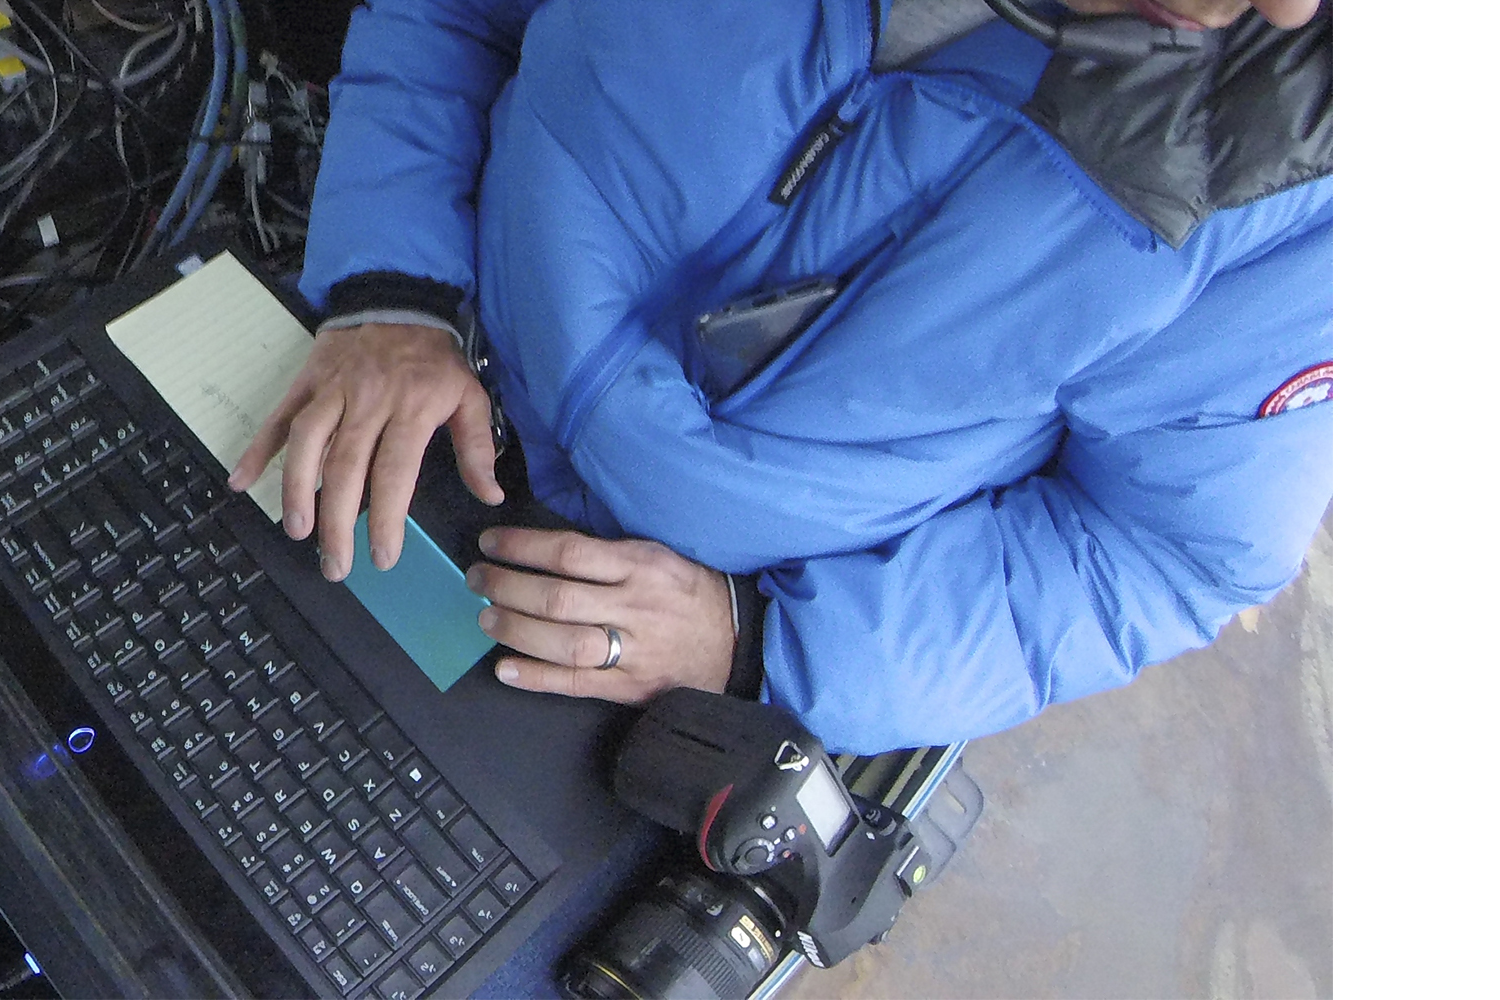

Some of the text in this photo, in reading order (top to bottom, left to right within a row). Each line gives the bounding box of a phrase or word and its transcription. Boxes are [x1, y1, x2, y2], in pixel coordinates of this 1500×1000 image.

[132, 612, 145, 624] P
[180, 611, 191, 626] L
[154, 639, 166, 652] O
[239, 631, 253, 647] M
[200, 639, 213, 654] K
[264, 660, 277, 675] N
[200, 698, 213, 712] U
[247, 697, 261, 712] H
[289, 691, 302, 705] B
[272, 728, 285, 741] G
[313, 721, 326, 734] V
[224, 731, 237, 745] Y
[338, 749, 350, 762] C
[249, 761, 261, 775] T
[298, 761, 311, 773] F
[363, 778, 376, 793] X
[274, 789, 288, 804] R
[323, 788, 335, 802] D
[388, 808, 402, 822] Z
[299, 820, 313, 834] E
[347, 818, 360, 831] S
[321, 848, 337, 865] W
[374, 846, 387, 860] A
[350, 880, 363, 894] Q
